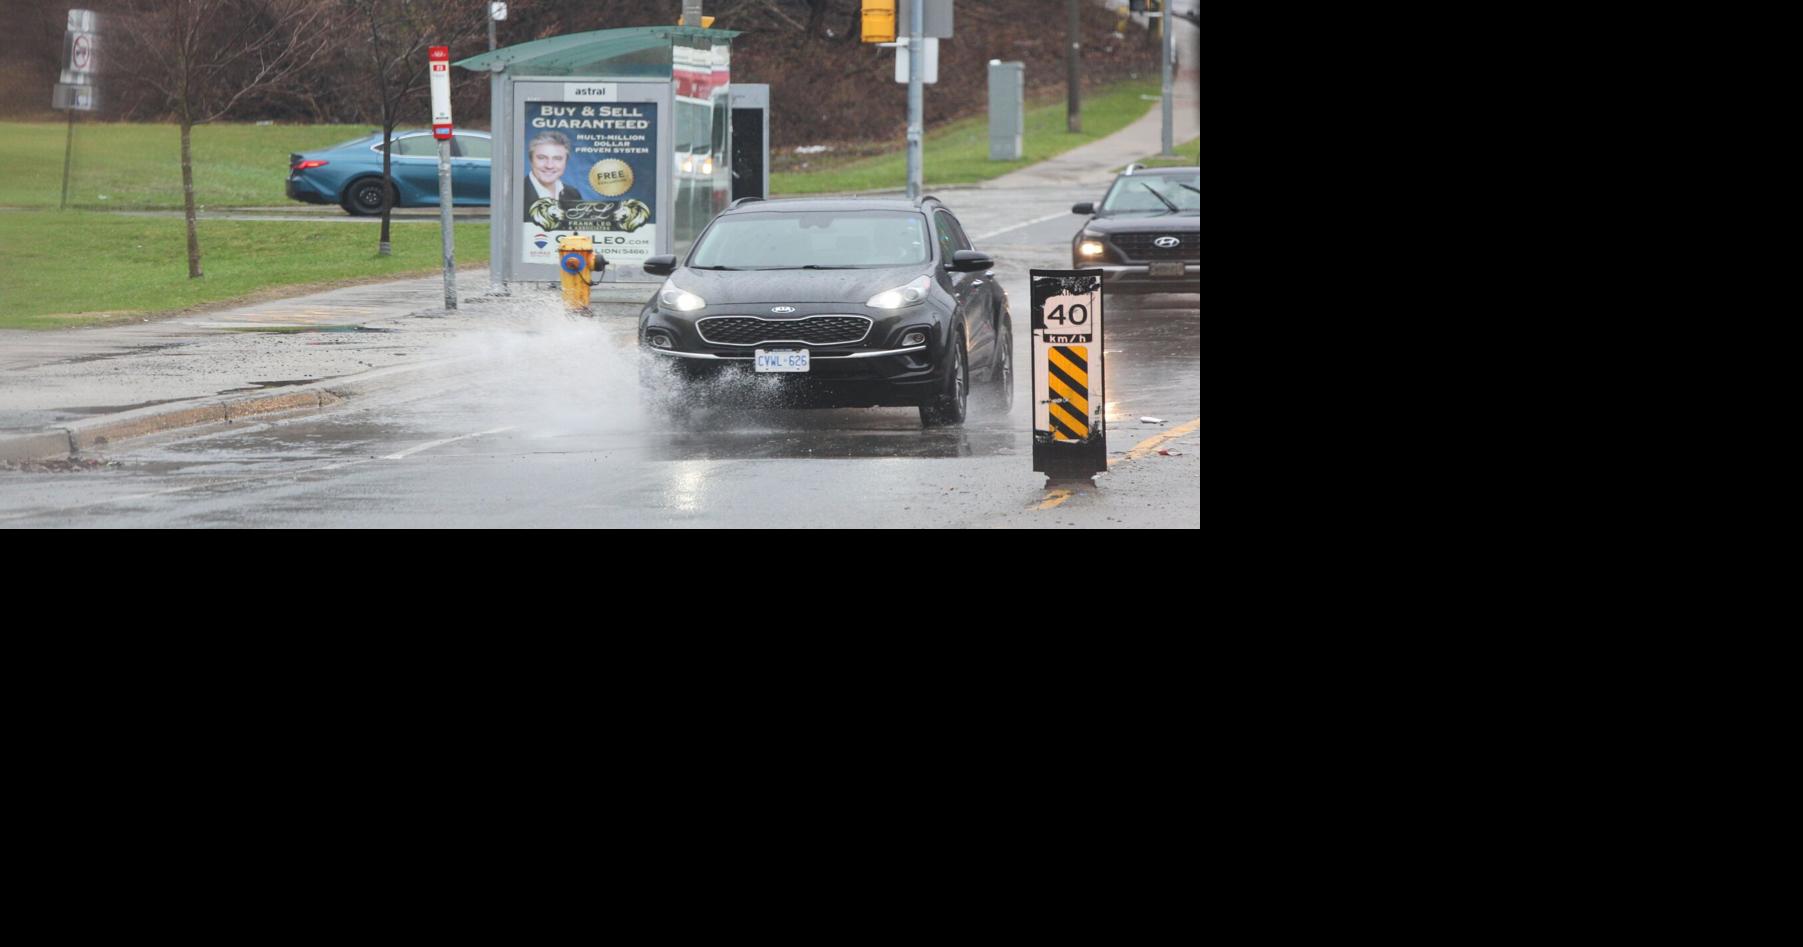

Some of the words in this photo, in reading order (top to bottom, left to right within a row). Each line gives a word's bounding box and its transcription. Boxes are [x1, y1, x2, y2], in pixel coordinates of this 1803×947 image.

[575, 87, 606, 96] astral
[541, 105, 576, 116] BUY
[581, 105, 595, 116] &
[600, 106, 643, 117] SELL
[532, 117, 649, 129] GUARANTEED
[597, 170, 625, 180] FREE
[1047, 304, 1088, 325] 40
[1049, 334, 1086, 343] km/h
